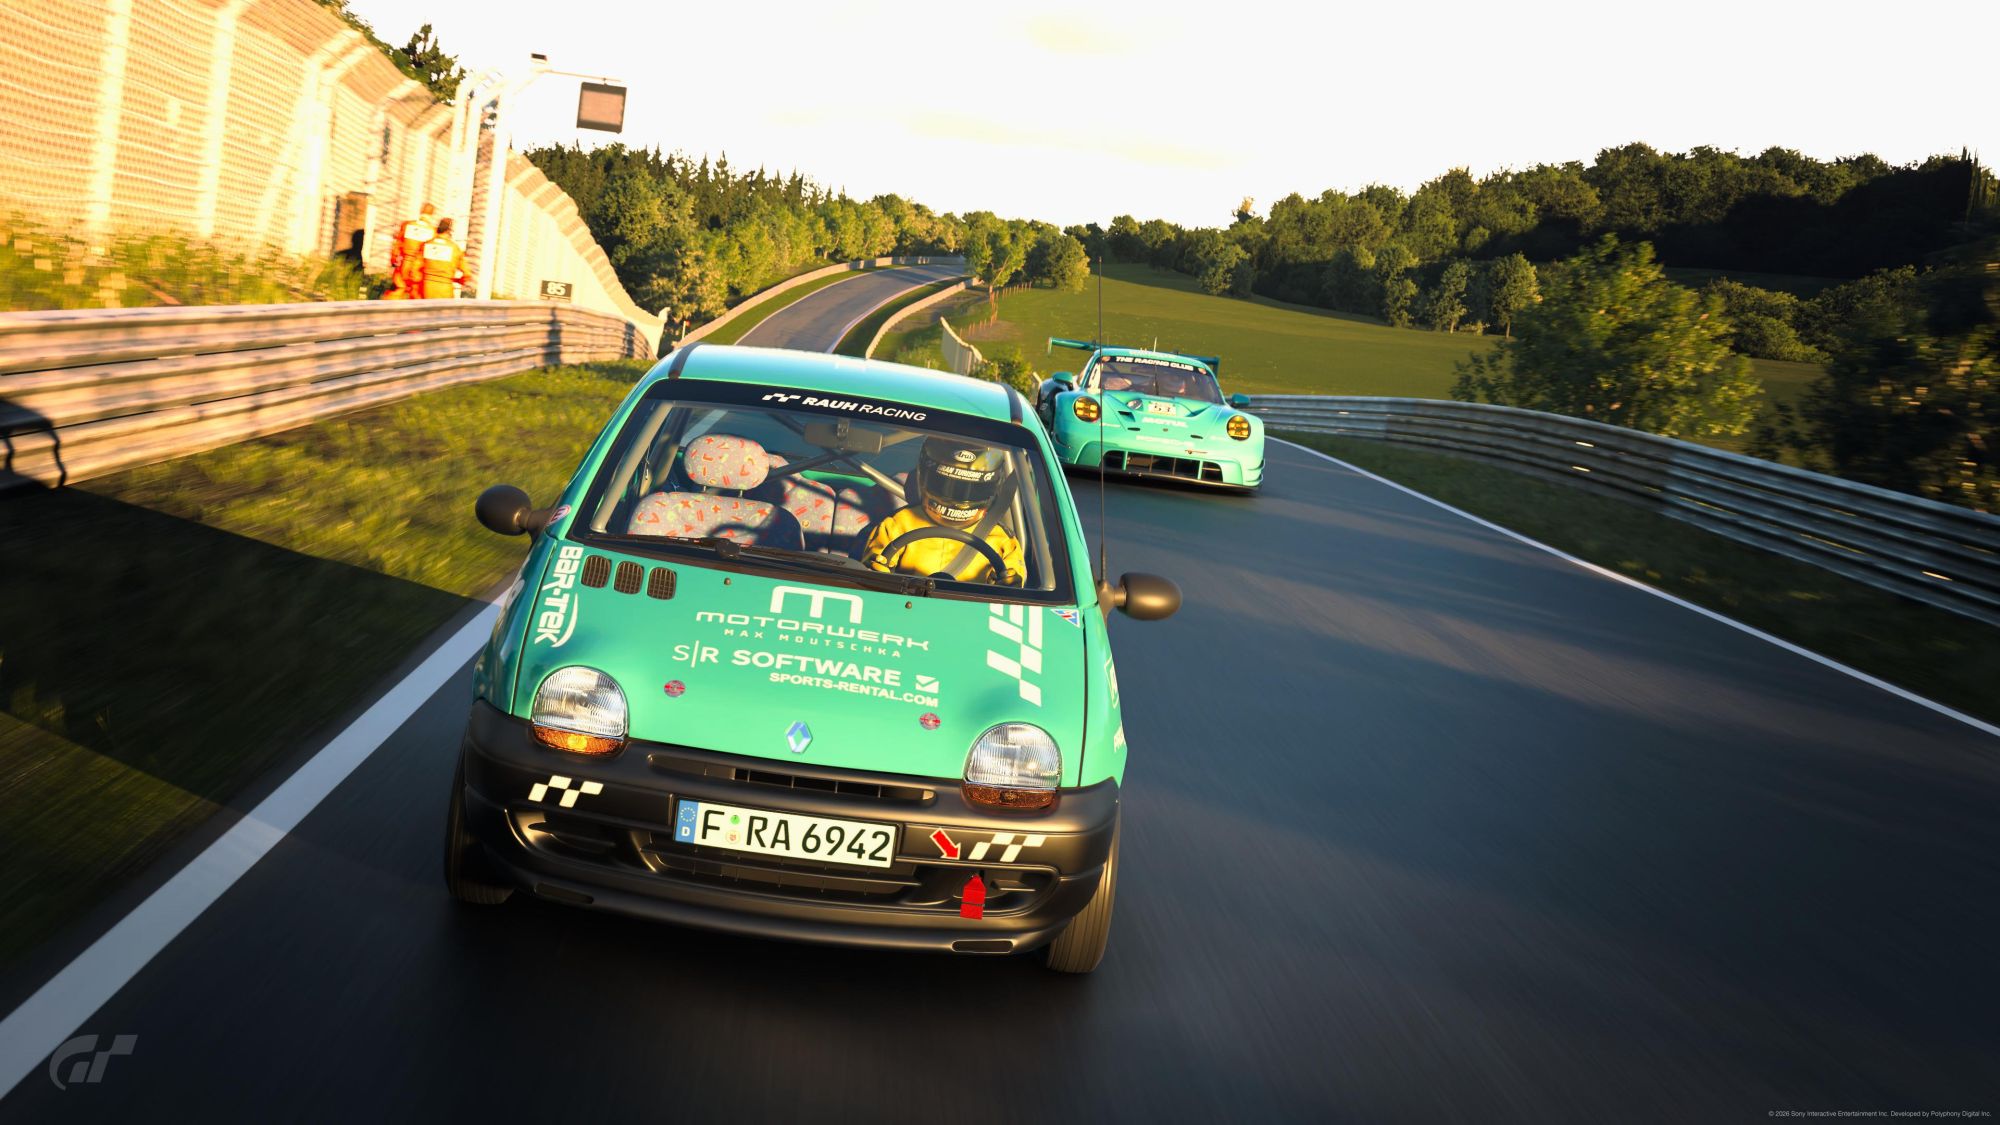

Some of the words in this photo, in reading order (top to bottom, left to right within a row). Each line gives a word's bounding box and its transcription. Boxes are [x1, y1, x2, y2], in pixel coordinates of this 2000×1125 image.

[1134, 358, 1169, 368] RACING
[1169, 362, 1194, 372] CLUB
[802, 396, 858, 411] RAUH
[859, 404, 927, 421] RACING
[695, 611, 930, 651] MOTORWERK
[724, 628, 764, 639] MAX
[779, 634, 902, 658] MOUTSCHKA
[731, 649, 902, 687] SOFTWARE
[769, 672, 939, 707] SPORTS-RENTAL.COM
[680, 826, 691, 837] D
[701, 809, 725, 839] F
[746, 815, 791, 851] RA
[801, 823, 891, 862] 6942
